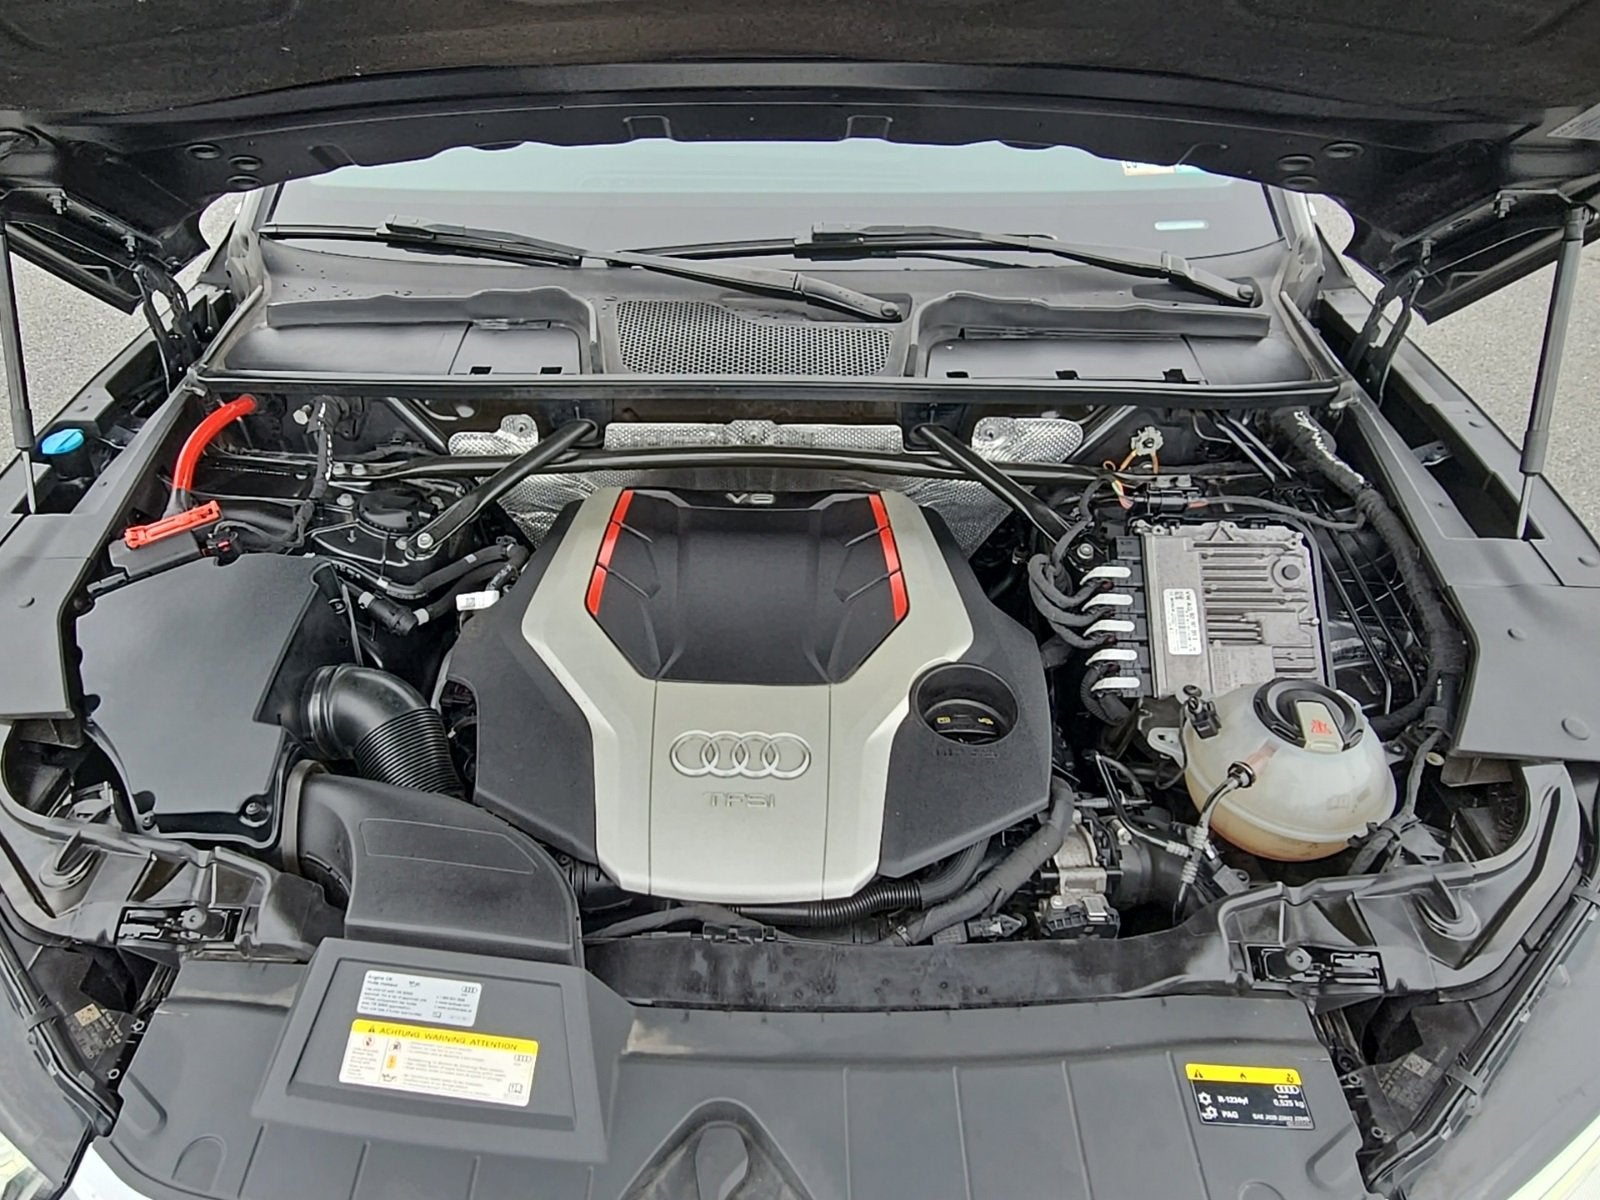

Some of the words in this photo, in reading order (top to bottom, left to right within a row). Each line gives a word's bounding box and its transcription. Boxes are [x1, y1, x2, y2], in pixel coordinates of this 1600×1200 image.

[725, 492, 776, 505] V6
[702, 791, 776, 808] TFSI
[379, 1027, 421, 1039] ACHTUNG
[424, 1032, 467, 1045] WARNING
[469, 1038, 518, 1051] ATTENTION
